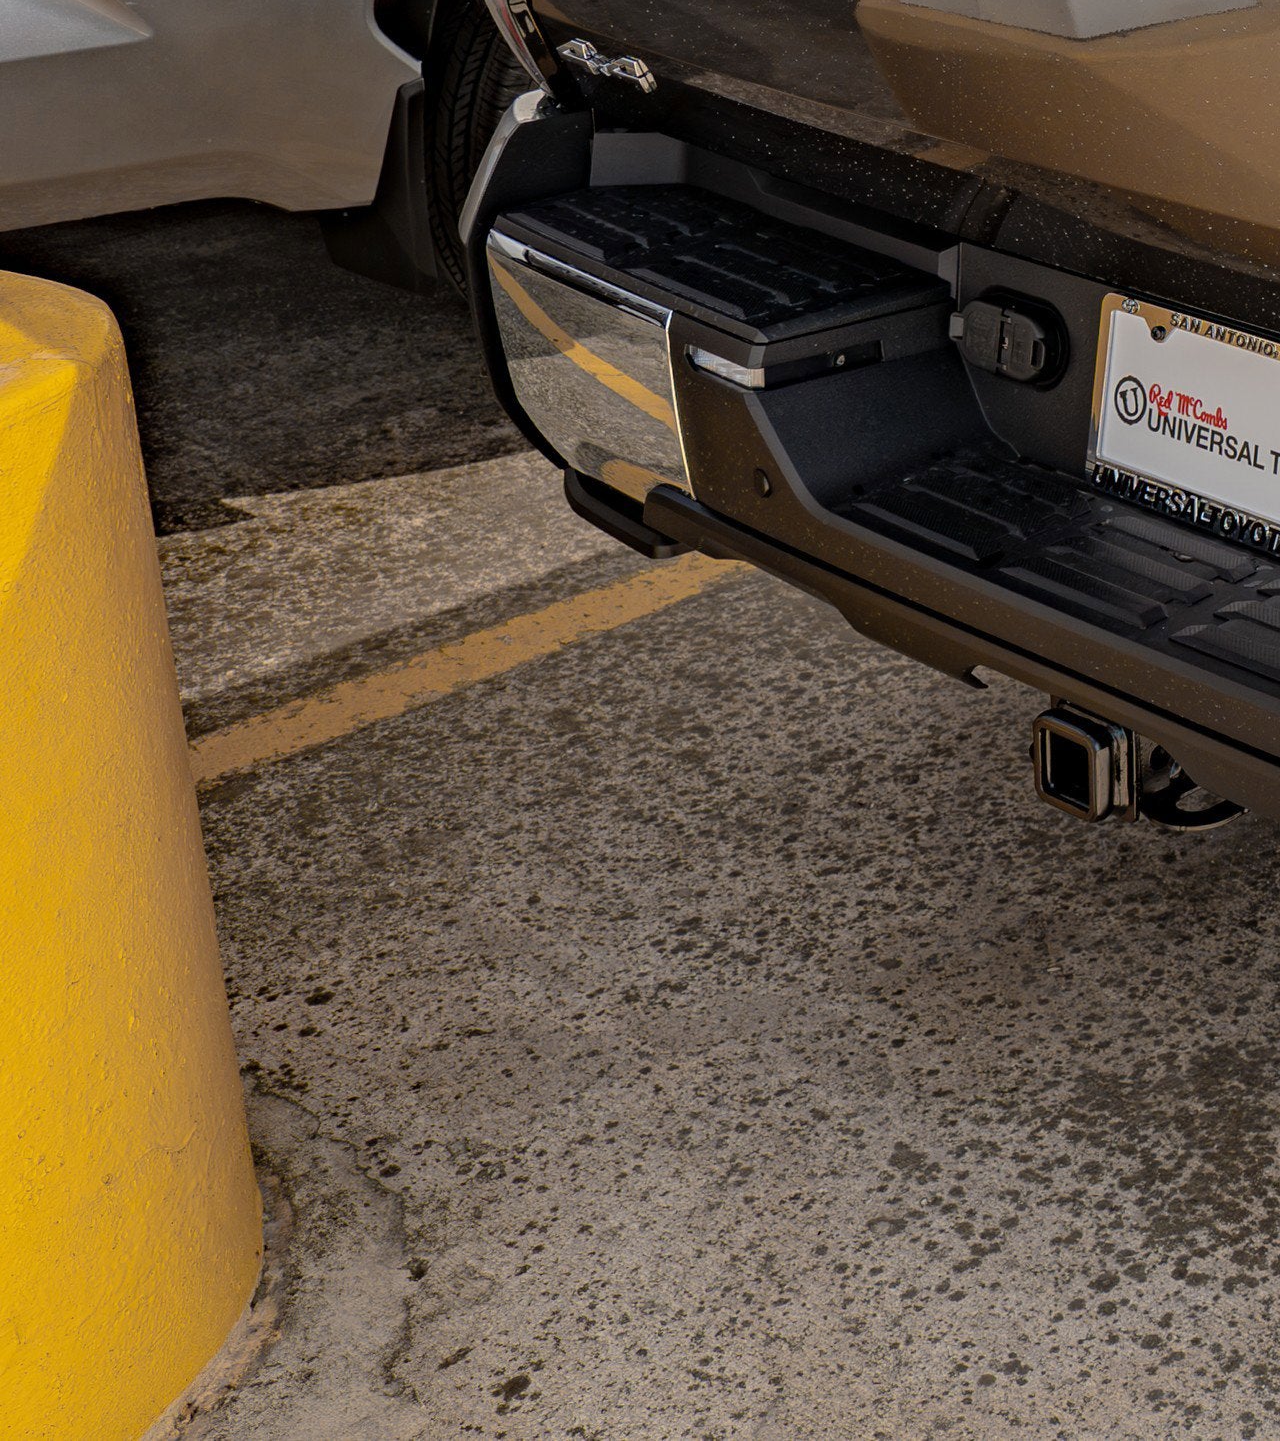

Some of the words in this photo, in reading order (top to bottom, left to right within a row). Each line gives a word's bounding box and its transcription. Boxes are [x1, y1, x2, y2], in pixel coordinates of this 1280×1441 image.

[1169, 312, 1202, 335] SAN
[1205, 323, 1280, 359] ANTONIO,
[1148, 382, 1173, 416] Red
[1174, 391, 1229, 431] McCombs
[1147, 408, 1266, 472] UNIVERSAL
